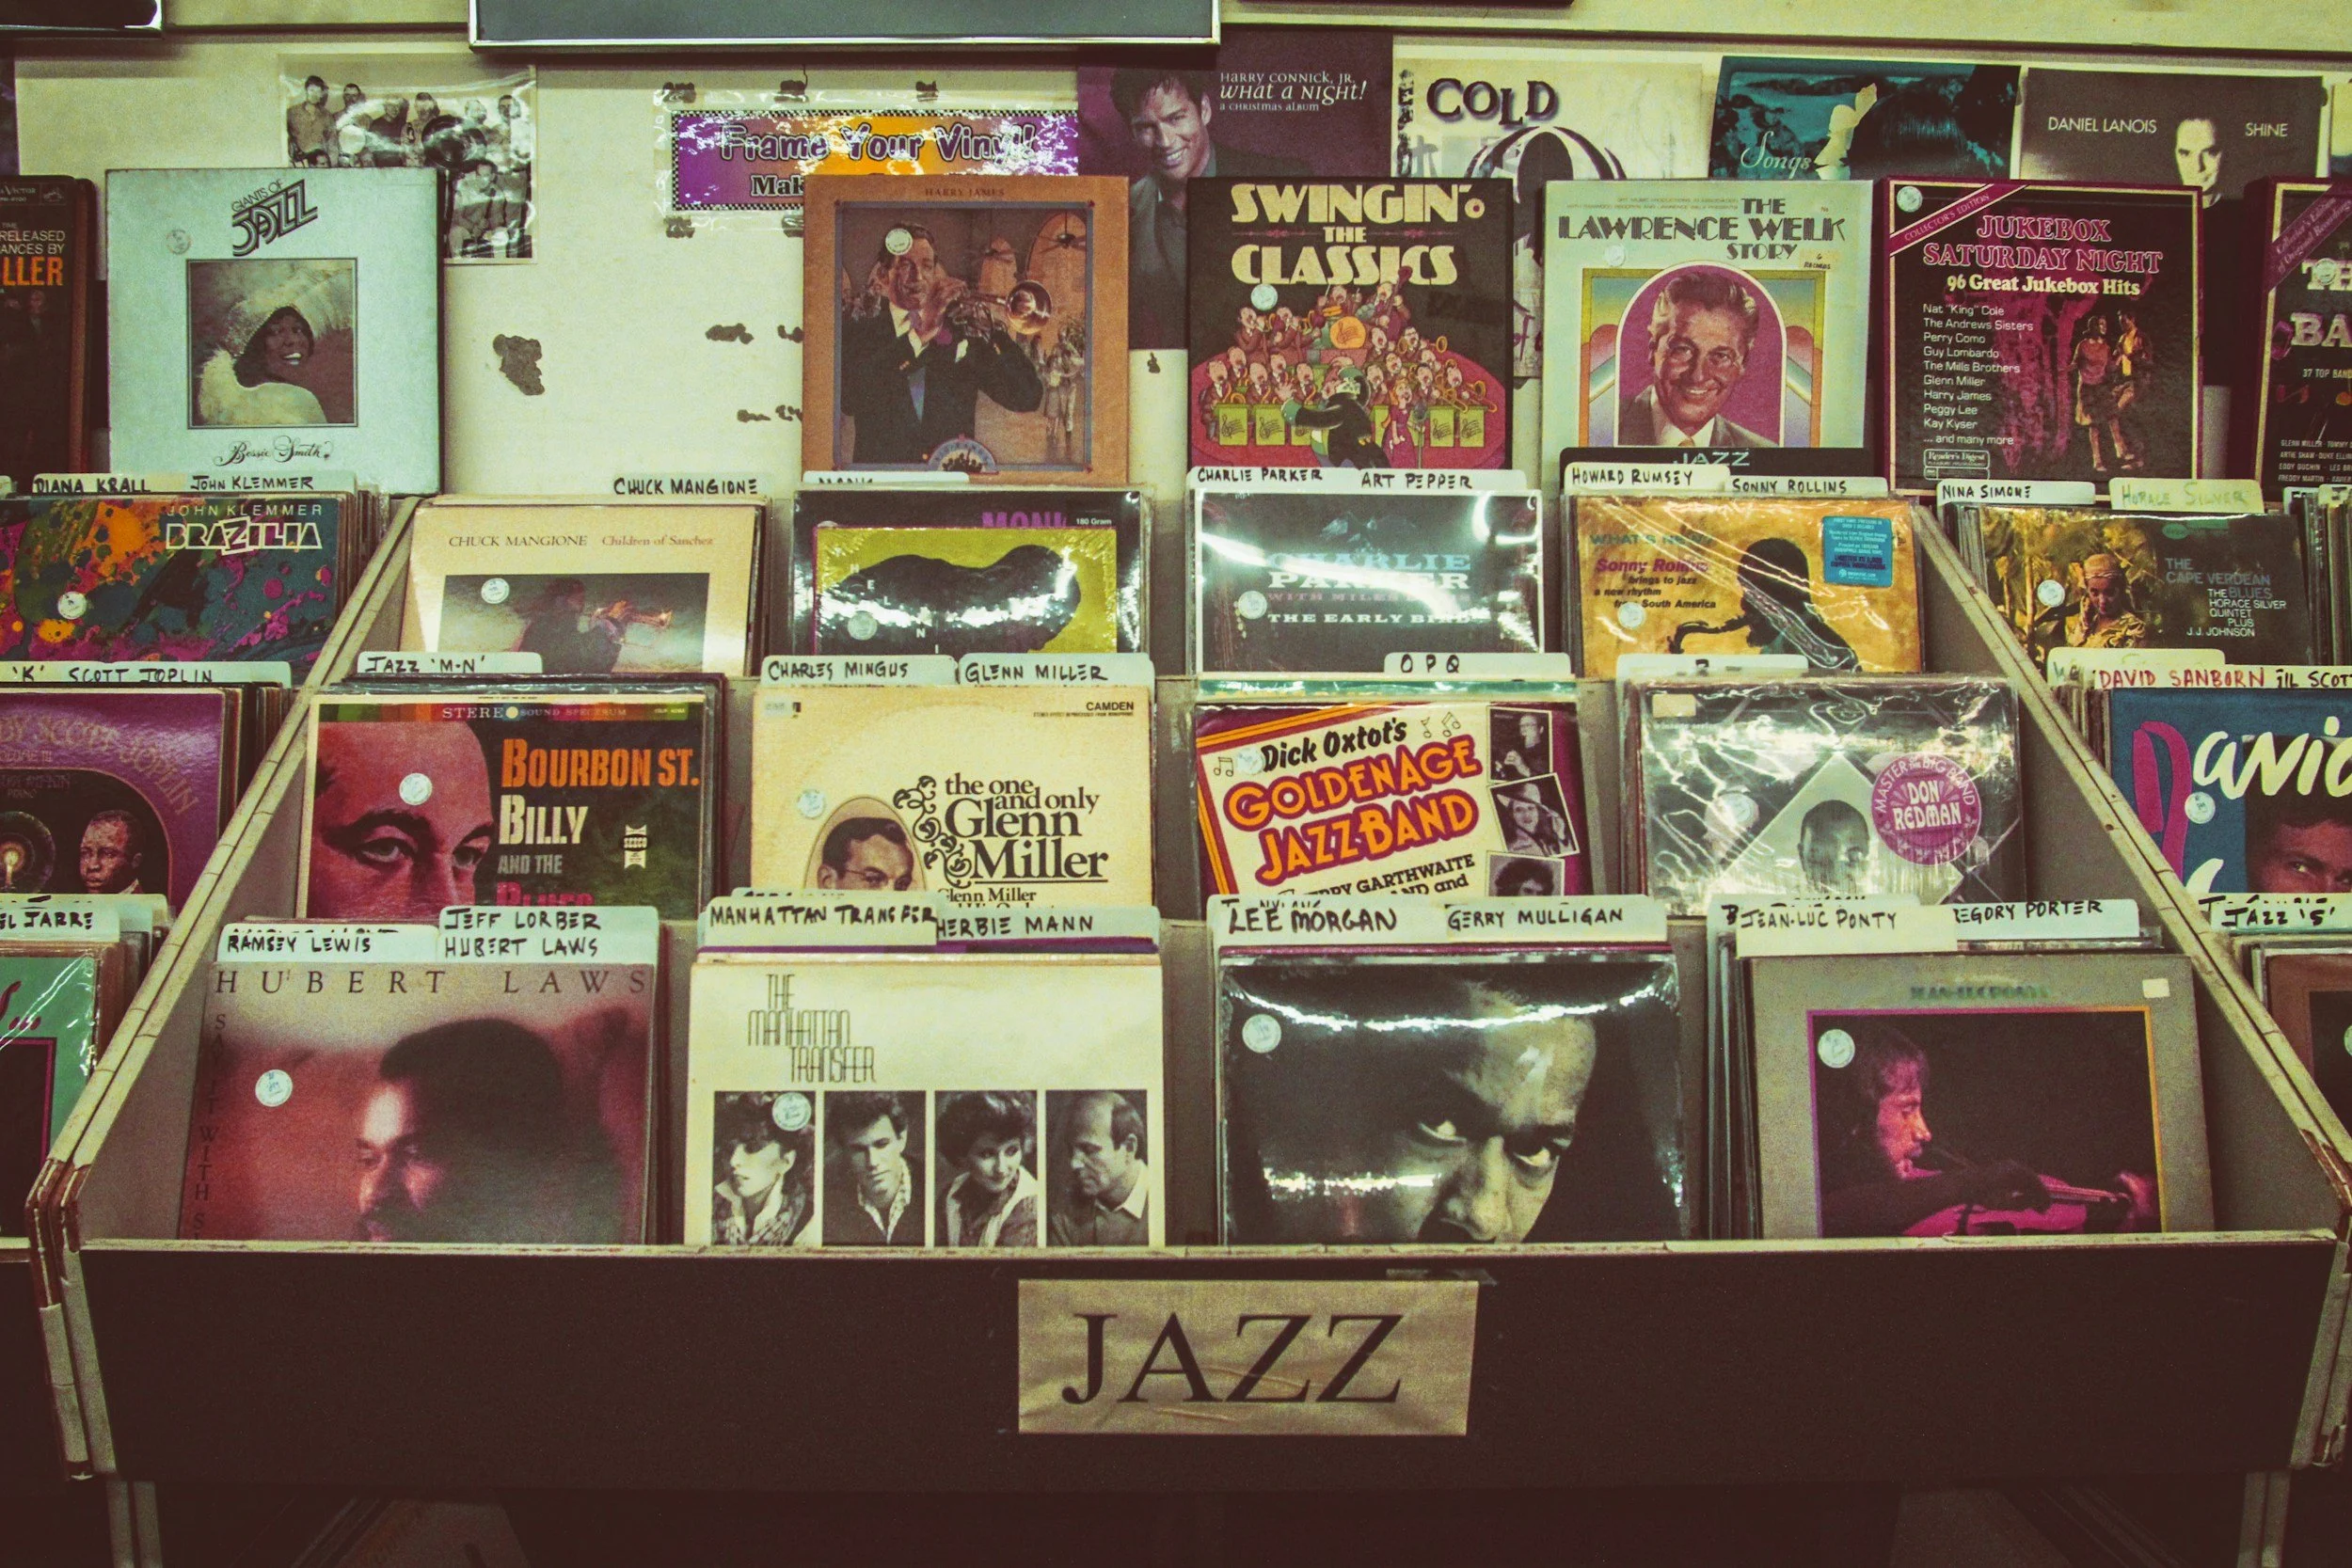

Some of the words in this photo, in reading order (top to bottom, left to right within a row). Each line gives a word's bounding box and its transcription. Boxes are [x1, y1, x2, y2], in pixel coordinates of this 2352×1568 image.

[1425, 76, 1559, 126] COLD
[2047, 116, 2100, 133] DANIEL
[2102, 118, 2158, 135] LANOIS
[2245, 122, 2288, 138] SHINE
[718, 122, 832, 161] Frame
[839, 122, 925, 161] Your
[1740, 130, 1813, 173] Songs
[230, 186, 269, 213] GIANTS
[268, 178, 285, 195] OF
[926, 188, 965, 198] HARRY
[968, 189, 1006, 198] JAMES
[1231, 183, 1473, 224] SWINGIN'
[1740, 198, 1787, 215] THE
[231, 178, 318, 257] JAZZ
[1903, 208, 1957, 242] COLLECTOR'S
[1956, 192, 1991, 216] EDITION
[1323, 227, 1367, 244] THE
[1558, 215, 1739, 242] LAWRENCE
[1748, 217, 1846, 242] WELK
[1977, 214, 2112, 242] JUKEBOX
[47, 244, 65, 255] BY
[1726, 243, 1798, 261] STORY
[1923, 243, 2071, 271] SATURDAY
[2075, 248, 2164, 275] NIGHT
[3, 256, 63, 287] LLER
[1231, 244, 1458, 286] CLASSICS
[1947, 274, 1967, 292] 96
[1969, 275, 2020, 293] Great
[2022, 277, 2100, 295] Jukebox
[2102, 278, 2141, 296] Hits
[1923, 303, 1944, 314] Nat
[1981, 306, 2005, 316] Cole
[1924, 317, 1943, 328] The
[1945, 319, 1992, 329] Andrews
[1994, 321, 2034, 331] Sisters
[1924, 332, 1953, 345] Perry
[1955, 333, 1986, 344] Como
[1924, 346, 1945, 357] Guy
[1947, 347, 1999, 359] Lombardo
[1924, 360, 1943, 371] The
[1946, 361, 1970, 372] Mills
[1972, 362, 2020, 373] Brothers
[1924, 375, 1954, 386] Glenn
[1956, 375, 1986, 387] Miller
[1924, 389, 1954, 402] Harry
[1956, 391, 1992, 402] James
[1924, 404, 1956, 416] Peggy
[1959, 404, 1978, 415] Lee
[1924, 419, 1944, 430] Kay
[1947, 419, 1978, 432] Kyser
[273, 436, 334, 463] Smith
[190, 475, 227, 490] JOHN
[232, 475, 314, 490] KLEMMER
[1198, 467, 1251, 483] CHARLIE
[1261, 467, 1323, 483] PARKER
[1361, 473, 1395, 489] ART
[1406, 473, 1473, 490] PEPPER
[1572, 467, 1625, 485] HOWARD
[1631, 467, 1693, 485] RUMSEY
[34, 477, 85, 494] DIANA
[97, 477, 151, 494] KRALL
[613, 478, 664, 496] CHUCK
[670, 478, 758, 496] MANGIONE
[1732, 479, 1776, 494] SONNY
[1788, 479, 1848, 494] ROLLINS
[1942, 484, 1975, 499] NINA
[1979, 485, 2031, 499] SIMONE
[167, 505, 219, 516] JOHN
[227, 504, 322, 516] KLEMMER
[1075, 517, 1089, 526] 180
[1090, 518, 1112, 527] Gram
[449, 535, 501, 547] CHUCK
[506, 534, 588, 547] MANGIONE
[602, 534, 651, 546] Children
[654, 534, 666, 546] of
[2165, 557, 2194, 570] THE
[1628, 575, 1661, 585] brings
[1677, 577, 1698, 585] jazz
[2166, 572, 2203, 584] CAPE
[2206, 572, 2271, 586] VERDEAN
[1627, 588, 1661, 596] rhythm
[2207, 588, 2228, 598] THE
[2228, 586, 2273, 600] BLUES
[2209, 598, 2250, 609] HORACE
[2253, 599, 2286, 610] SILVER
[2209, 608, 2252, 618] QUINTET
[1267, 613, 1317, 624] THE
[1324, 613, 1403, 624] EARLY
[2227, 618, 2255, 627] PLUS
[768, 660, 834, 681] CHARLES
[844, 660, 909, 678] MINGUS
[964, 662, 1025, 683] GLENN
[1034, 664, 1108, 683] MILLER
[1400, 654, 1414, 673] O
[1426, 654, 1437, 673] P
[1446, 653, 1460, 673] Q
[69, 666, 131, 683] SCOTT
[138, 668, 214, 683] JOPLIN
[520, 708, 561, 717] SOUND
[1086, 702, 1135, 711] CAMDEN
[1261, 740, 1317, 775] Dick
[1323, 717, 1407, 757] Oxtot's
[501, 738, 652, 788] BOURBON
[657, 748, 701, 787] ST.
[945, 772, 984, 796] the
[989, 780, 1034, 795] one
[1906, 780, 1940, 805] DON
[994, 786, 1041, 810] and
[1044, 786, 1100, 815] only
[499, 794, 589, 846] BILLY
[945, 797, 1083, 838] Glenn
[1892, 801, 1963, 831] REDMAN
[497, 854, 531, 875] AND
[534, 854, 563, 875] THE
[969, 837, 1109, 879] Miller
[1356, 854, 1476, 894] GARTHWAITE
[1434, 874, 1470, 893] and
[444, 908, 501, 930] JEFF
[514, 911, 602, 930] LORBER
[709, 905, 828, 927] MANHATTAN
[1228, 907, 1283, 934] LEE
[1292, 908, 1397, 933] MORGAN
[1447, 909, 1505, 931] GERRY
[1518, 908, 1624, 927] MULLIGAN
[1836, 909, 1898, 929] PONTY
[1025, 916, 1094, 936] MANN
[227, 935, 296, 954] RAMSEY
[310, 936, 373, 954] LEWIS
[444, 937, 527, 958] HUBERT
[542, 938, 598, 957] LAWS
[215, 969, 446, 994] HUBERT
[502, 969, 646, 994] LAWS
[766, 973, 796, 1010] THE
[747, 1008, 850, 1047] MANHATTAN
[788, 1045, 877, 1084] TRANSFER
[1060, 1311, 1406, 1405] JAZZ
